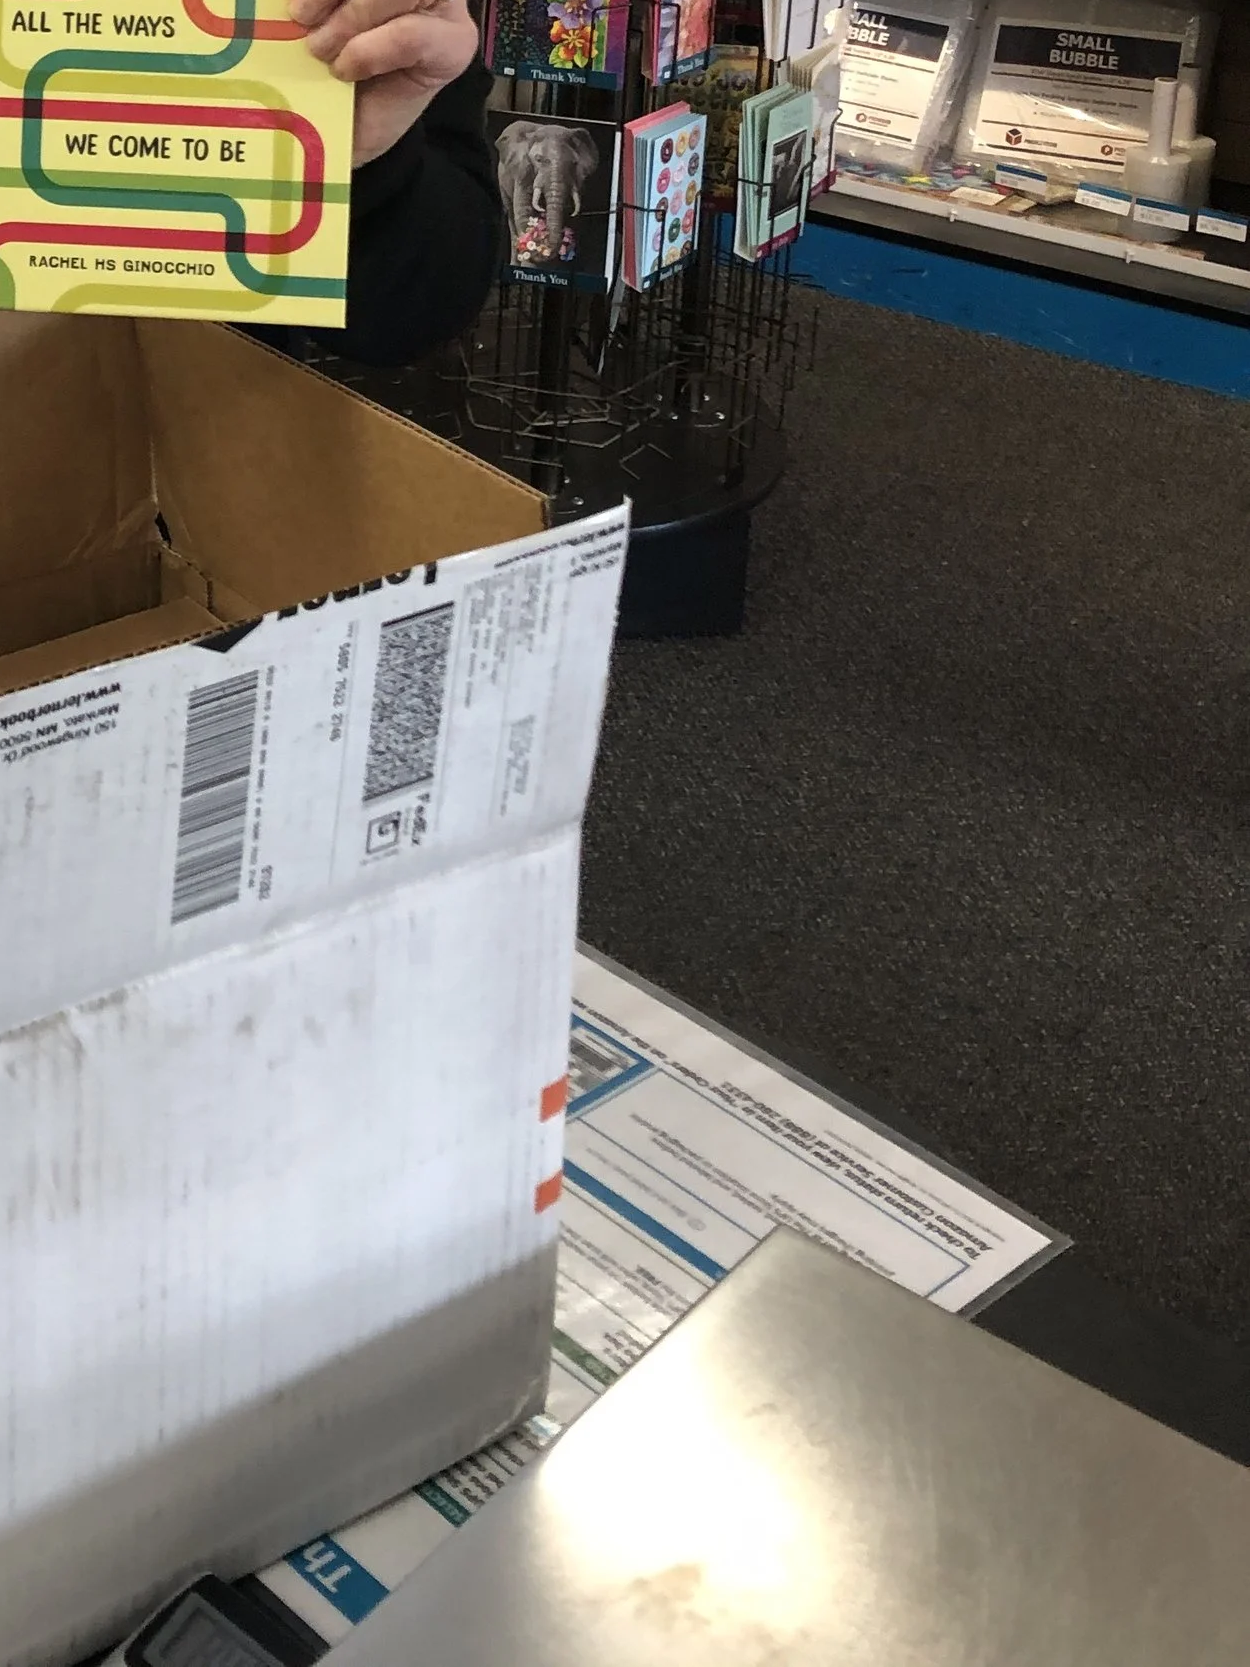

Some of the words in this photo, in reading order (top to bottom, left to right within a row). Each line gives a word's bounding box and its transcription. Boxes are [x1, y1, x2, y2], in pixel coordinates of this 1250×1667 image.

[11, 11, 51, 34] ALL
[63, 12, 102, 35] THE
[113, 15, 176, 38] WAYS
[1056, 33, 1116, 52] SMALL
[1050, 49, 1119, 70] BUBBLE
[531, 69, 564, 82] Thank
[568, 72, 586, 84] You
[65, 133, 98, 156] WE
[108, 136, 171, 160] COME
[182, 138, 210, 161] TO
[220, 140, 246, 163] BE
[29, 254, 87, 271] RACHEL
[95, 257, 116, 272] HS
[123, 258, 216, 277] GINOCCHIO
[513, 270, 546, 283] Thank
[550, 274, 568, 285] You
[830, 1148, 873, 1179] Service
[873, 1175, 933, 1218] Customer
[885, 1195, 925, 1225] return
[925, 1221, 963, 1249] check
[934, 1213, 992, 1254] Amazon
